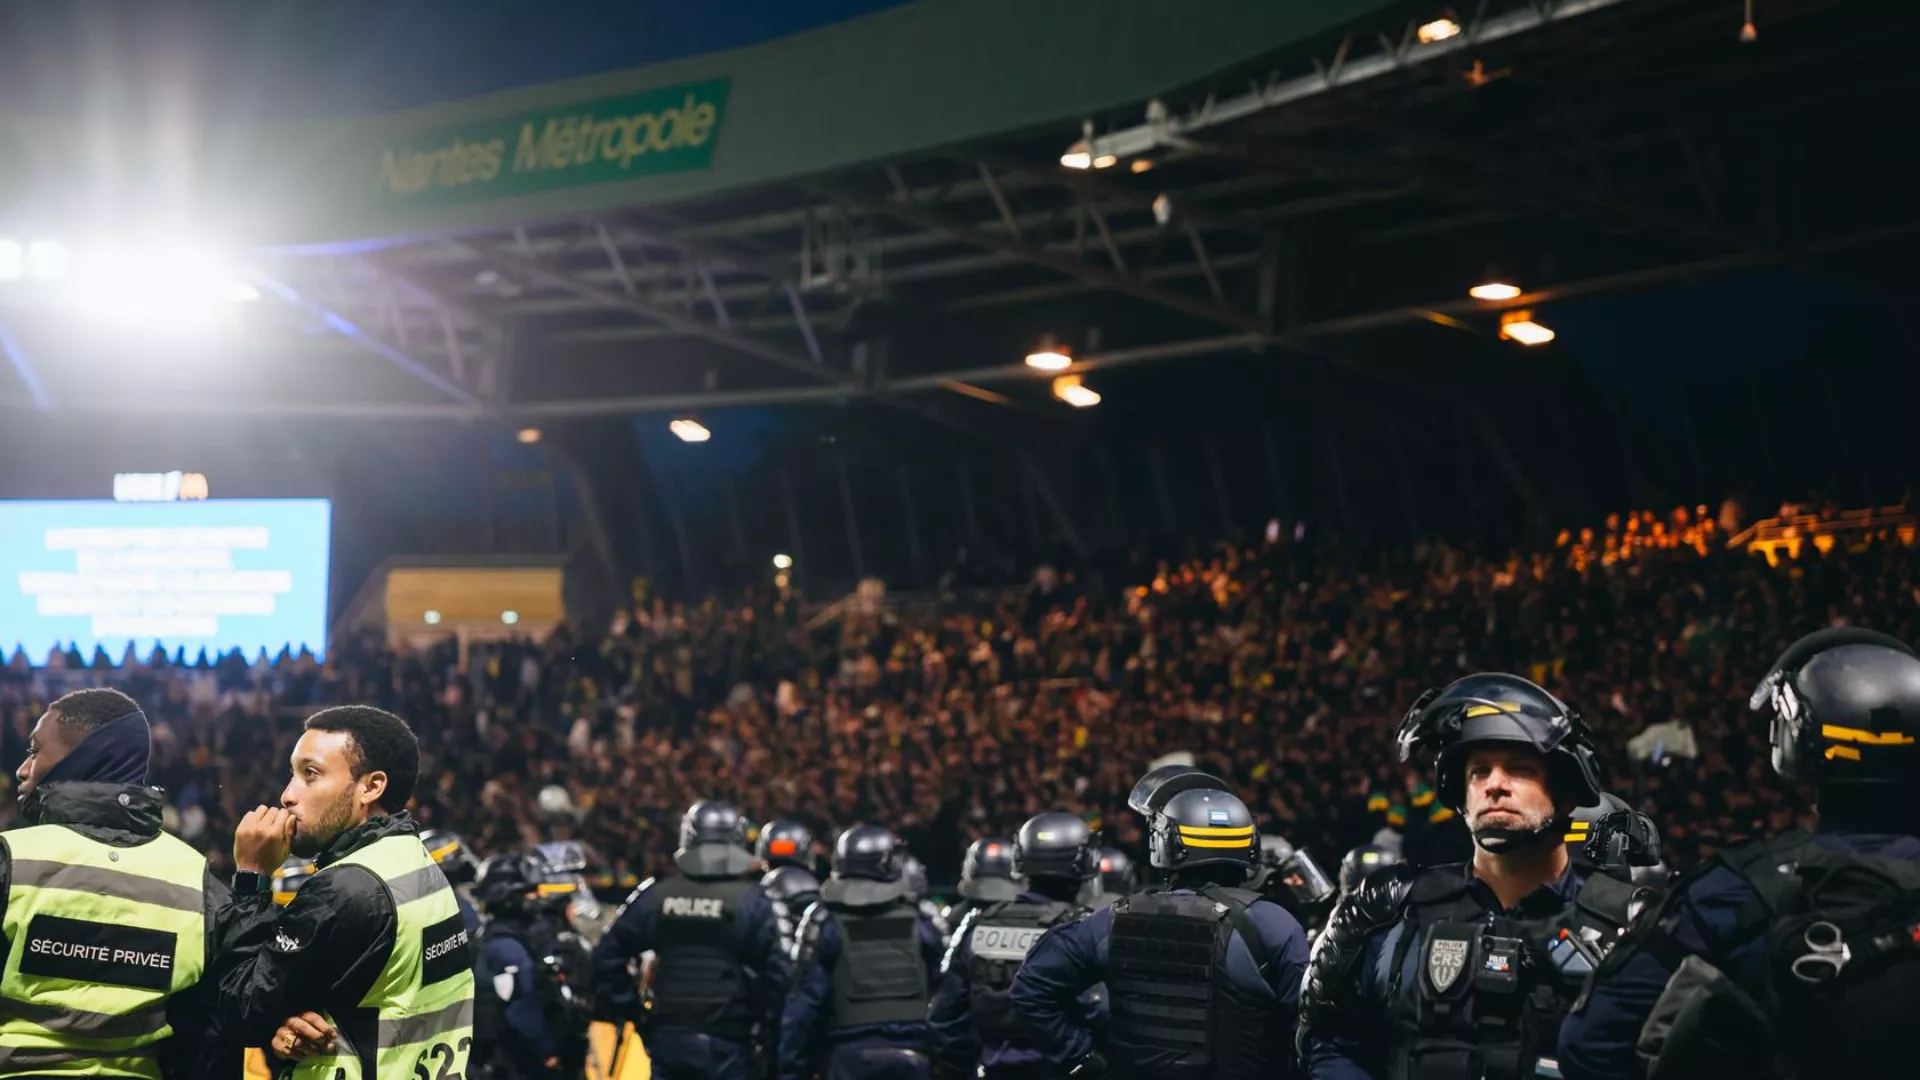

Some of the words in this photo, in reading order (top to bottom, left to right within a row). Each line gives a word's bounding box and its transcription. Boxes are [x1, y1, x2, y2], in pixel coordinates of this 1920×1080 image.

[380, 138, 506, 193] Nantes
[512, 92, 716, 174] Métropole
[662, 896, 725, 918] POLICE
[30, 938, 108, 962] SÉCURITÉ
[112, 948, 171, 969] PRIVÉE
[425, 934, 458, 961] SÉCURITÉ
[1431, 953, 1462, 967] CRS
